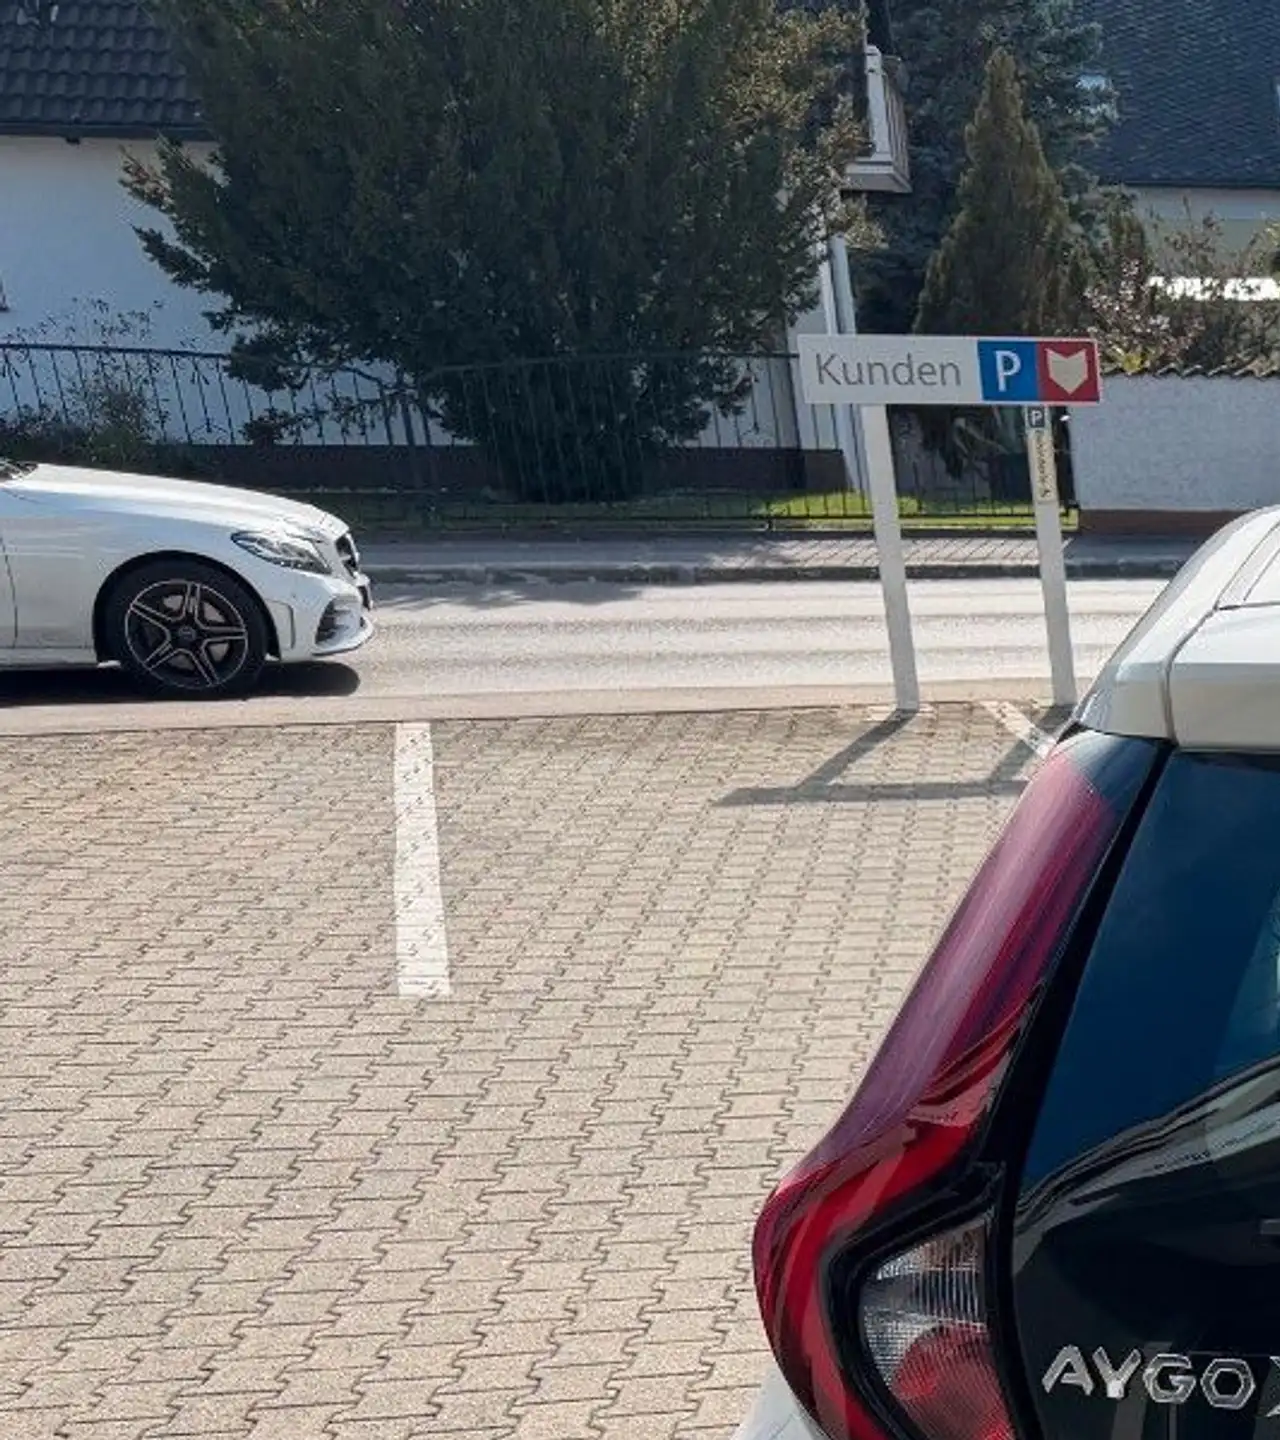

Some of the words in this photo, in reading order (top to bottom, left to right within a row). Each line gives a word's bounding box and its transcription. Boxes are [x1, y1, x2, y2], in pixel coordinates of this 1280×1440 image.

[815, 353, 962, 386] Kunden
[995, 350, 1021, 392] P
[1041, 1344, 1257, 1410] AYGO
